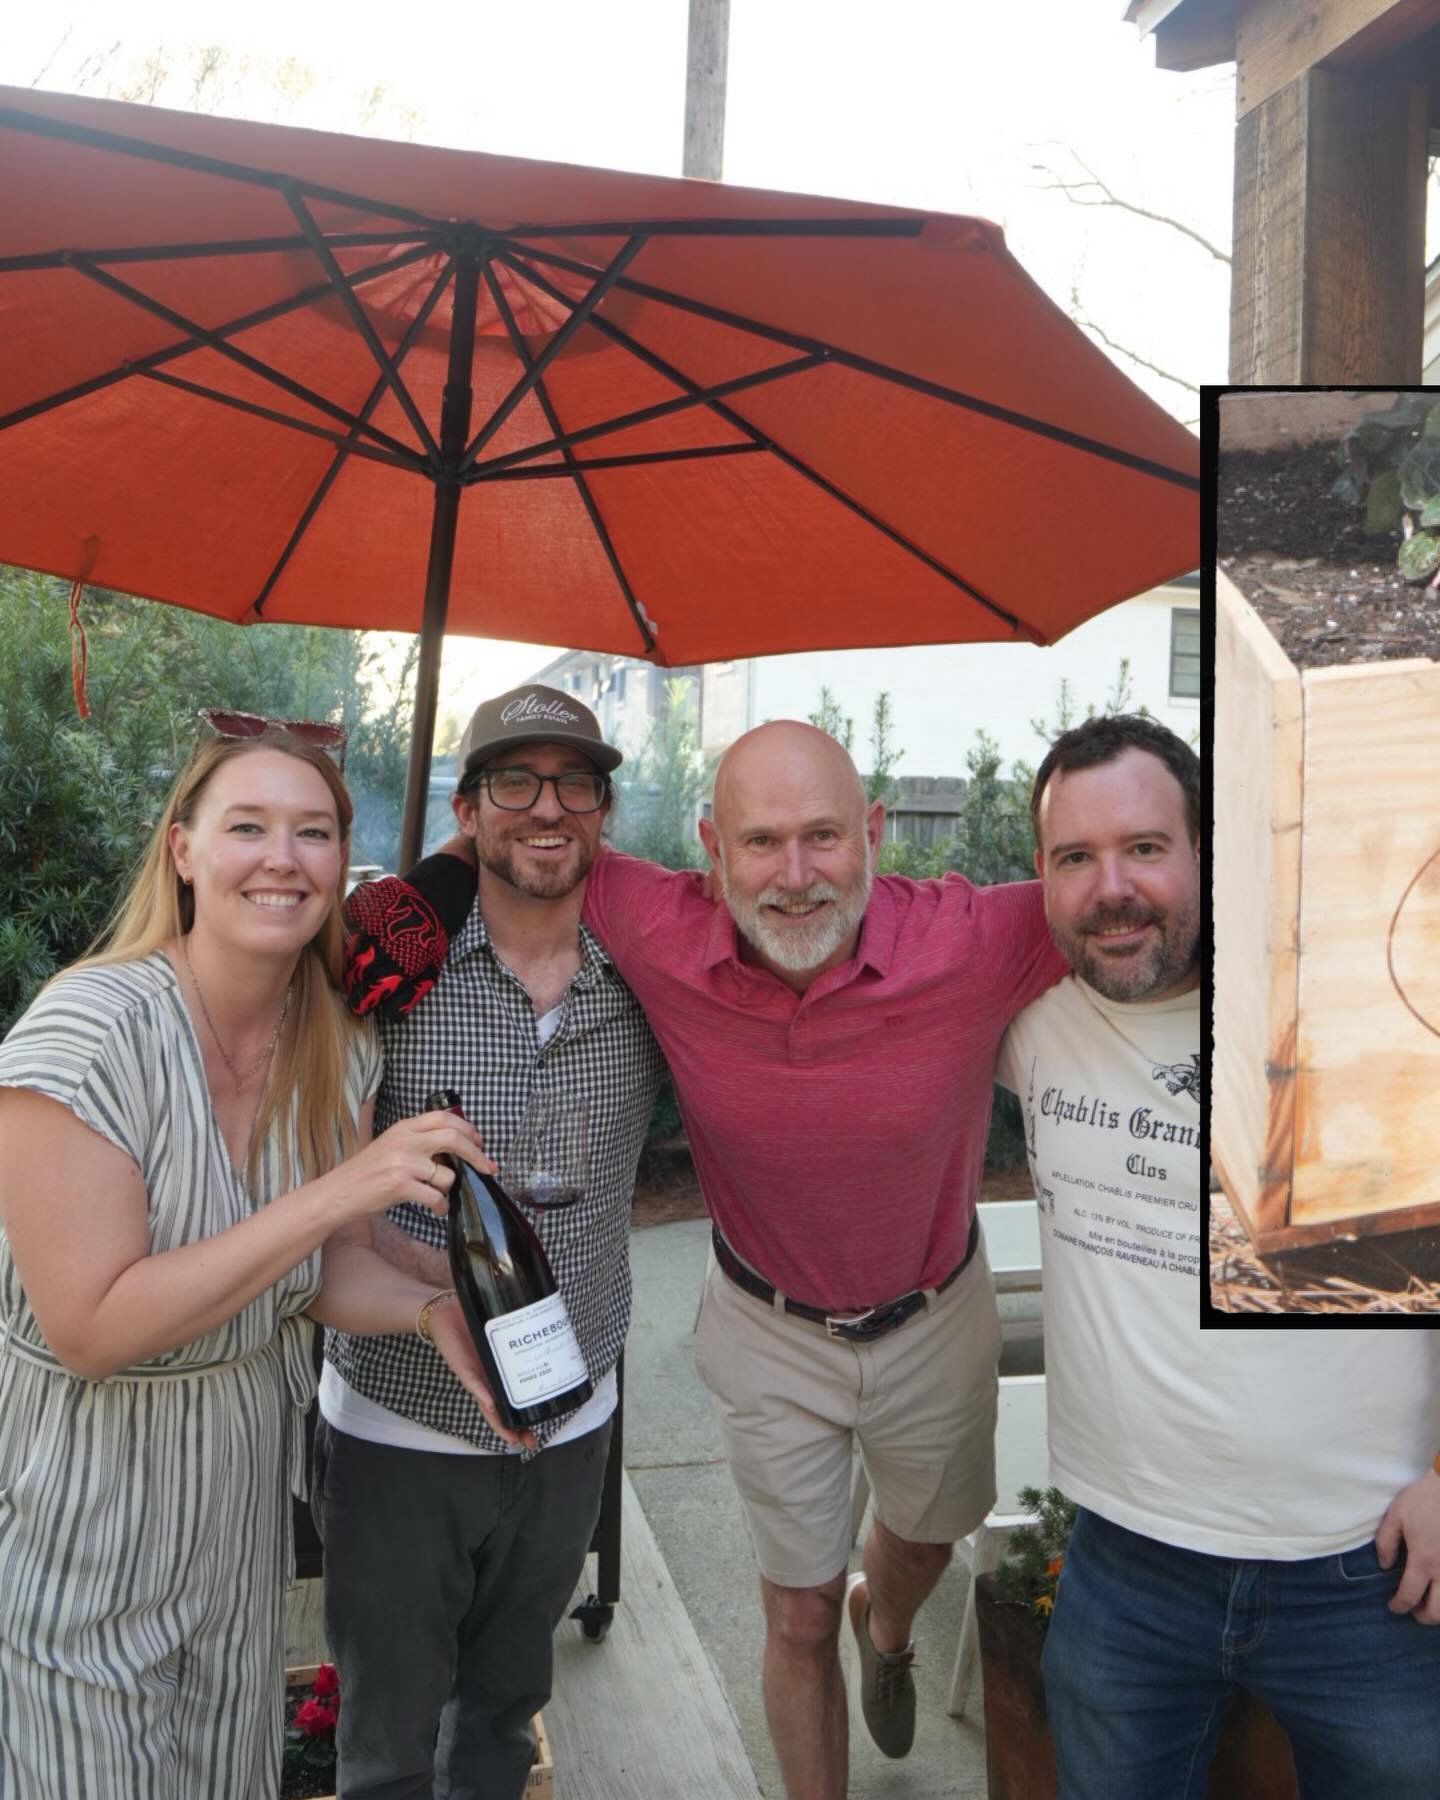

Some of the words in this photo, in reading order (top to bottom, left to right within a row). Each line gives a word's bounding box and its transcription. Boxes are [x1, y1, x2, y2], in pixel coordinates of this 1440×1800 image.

[501, 693, 578, 726] Stoller
[516, 714, 542, 723] FAMILY
[543, 714, 569, 725] ESTATE
[1041, 1086, 1121, 1130] Chablis
[1126, 1153, 1168, 1181] Clos
[1098, 1183, 1133, 1200] CHABLIS
[1135, 1192, 1176, 1208] PREMIER
[1178, 1201, 1198, 1212] CRU
[1105, 1215, 1116, 1225] BY
[1136, 1223, 1173, 1240] PRODUCE
[1175, 1232, 1187, 1241] OF
[1089, 1231, 1102, 1242] Mis
[1105, 1236, 1115, 1245] en
[1167, 1250, 1176, 1260] la
[1115, 1249, 1160, 1269] RAVENEAU
